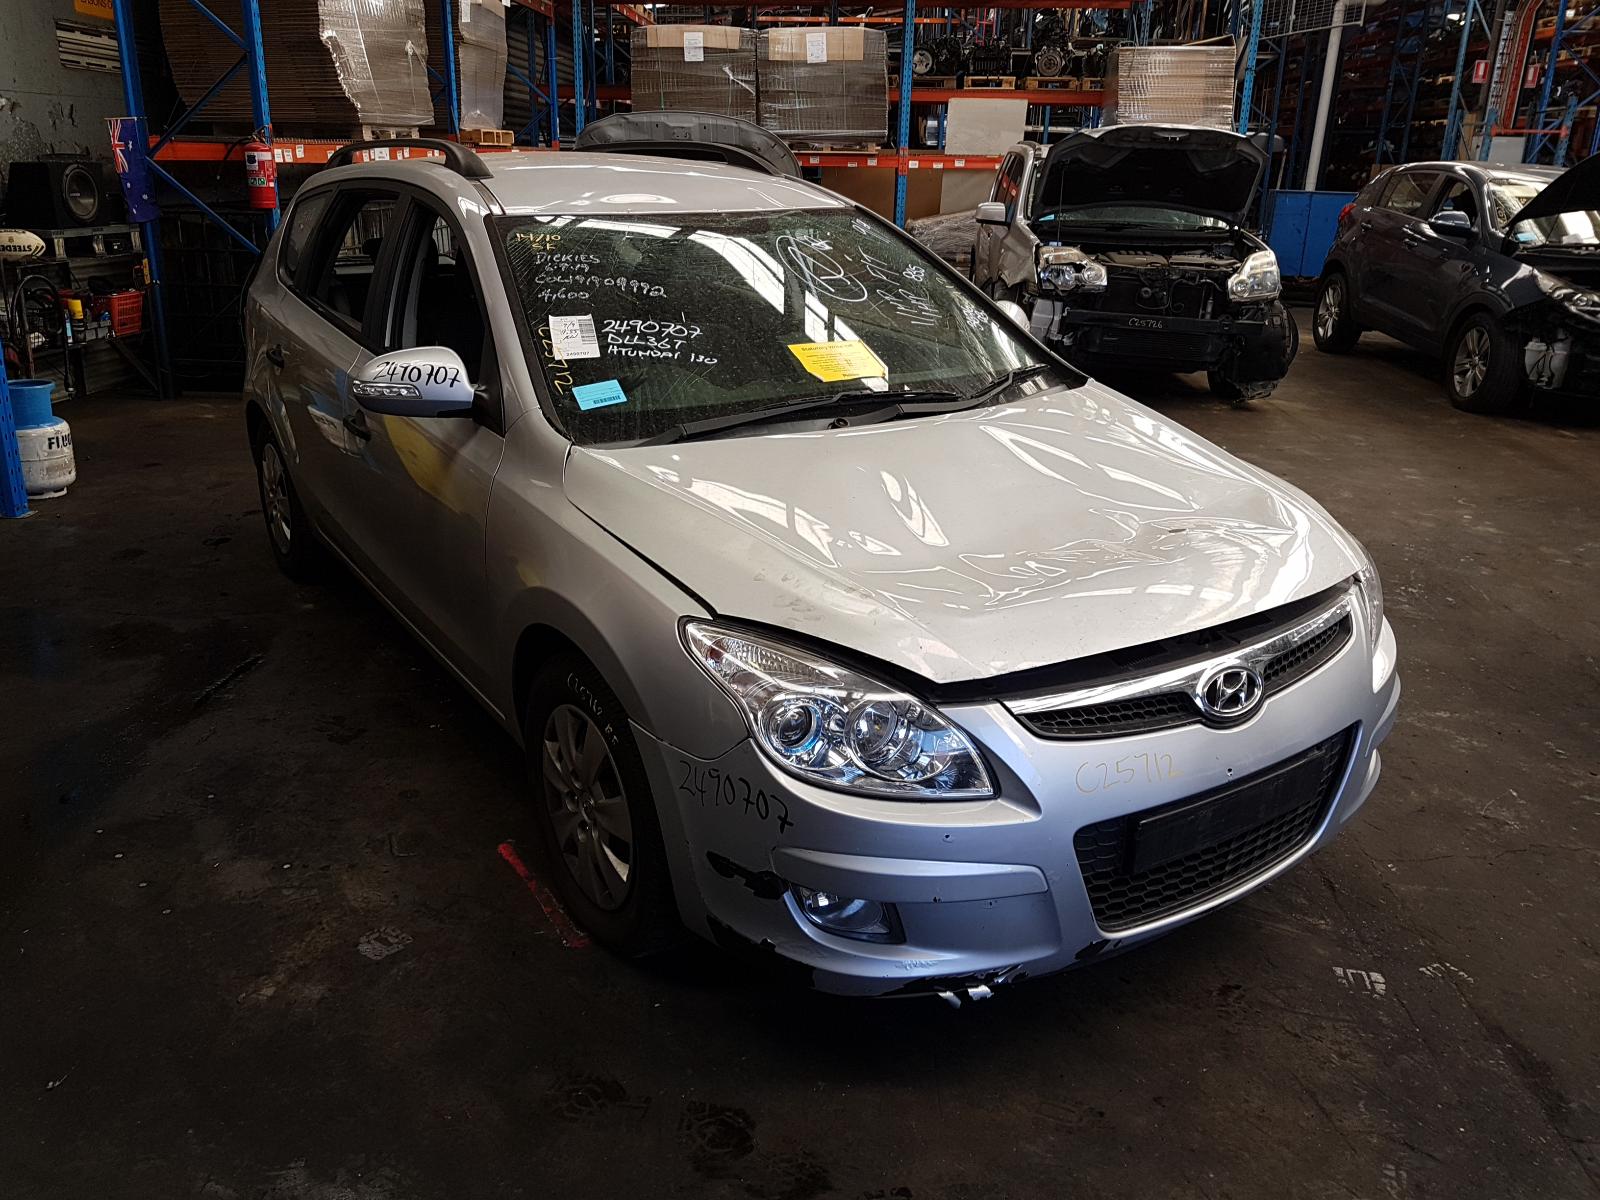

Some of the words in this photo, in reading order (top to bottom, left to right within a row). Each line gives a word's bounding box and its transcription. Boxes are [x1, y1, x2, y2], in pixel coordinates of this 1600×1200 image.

[536, 252, 600, 264] DICKIES
[601, 319, 703, 338] 2490707
[607, 333, 687, 350] DLL36T
[373, 361, 461, 388] 2490707
[1076, 752, 1184, 793] C25712
[679, 760, 794, 834] 2490707
